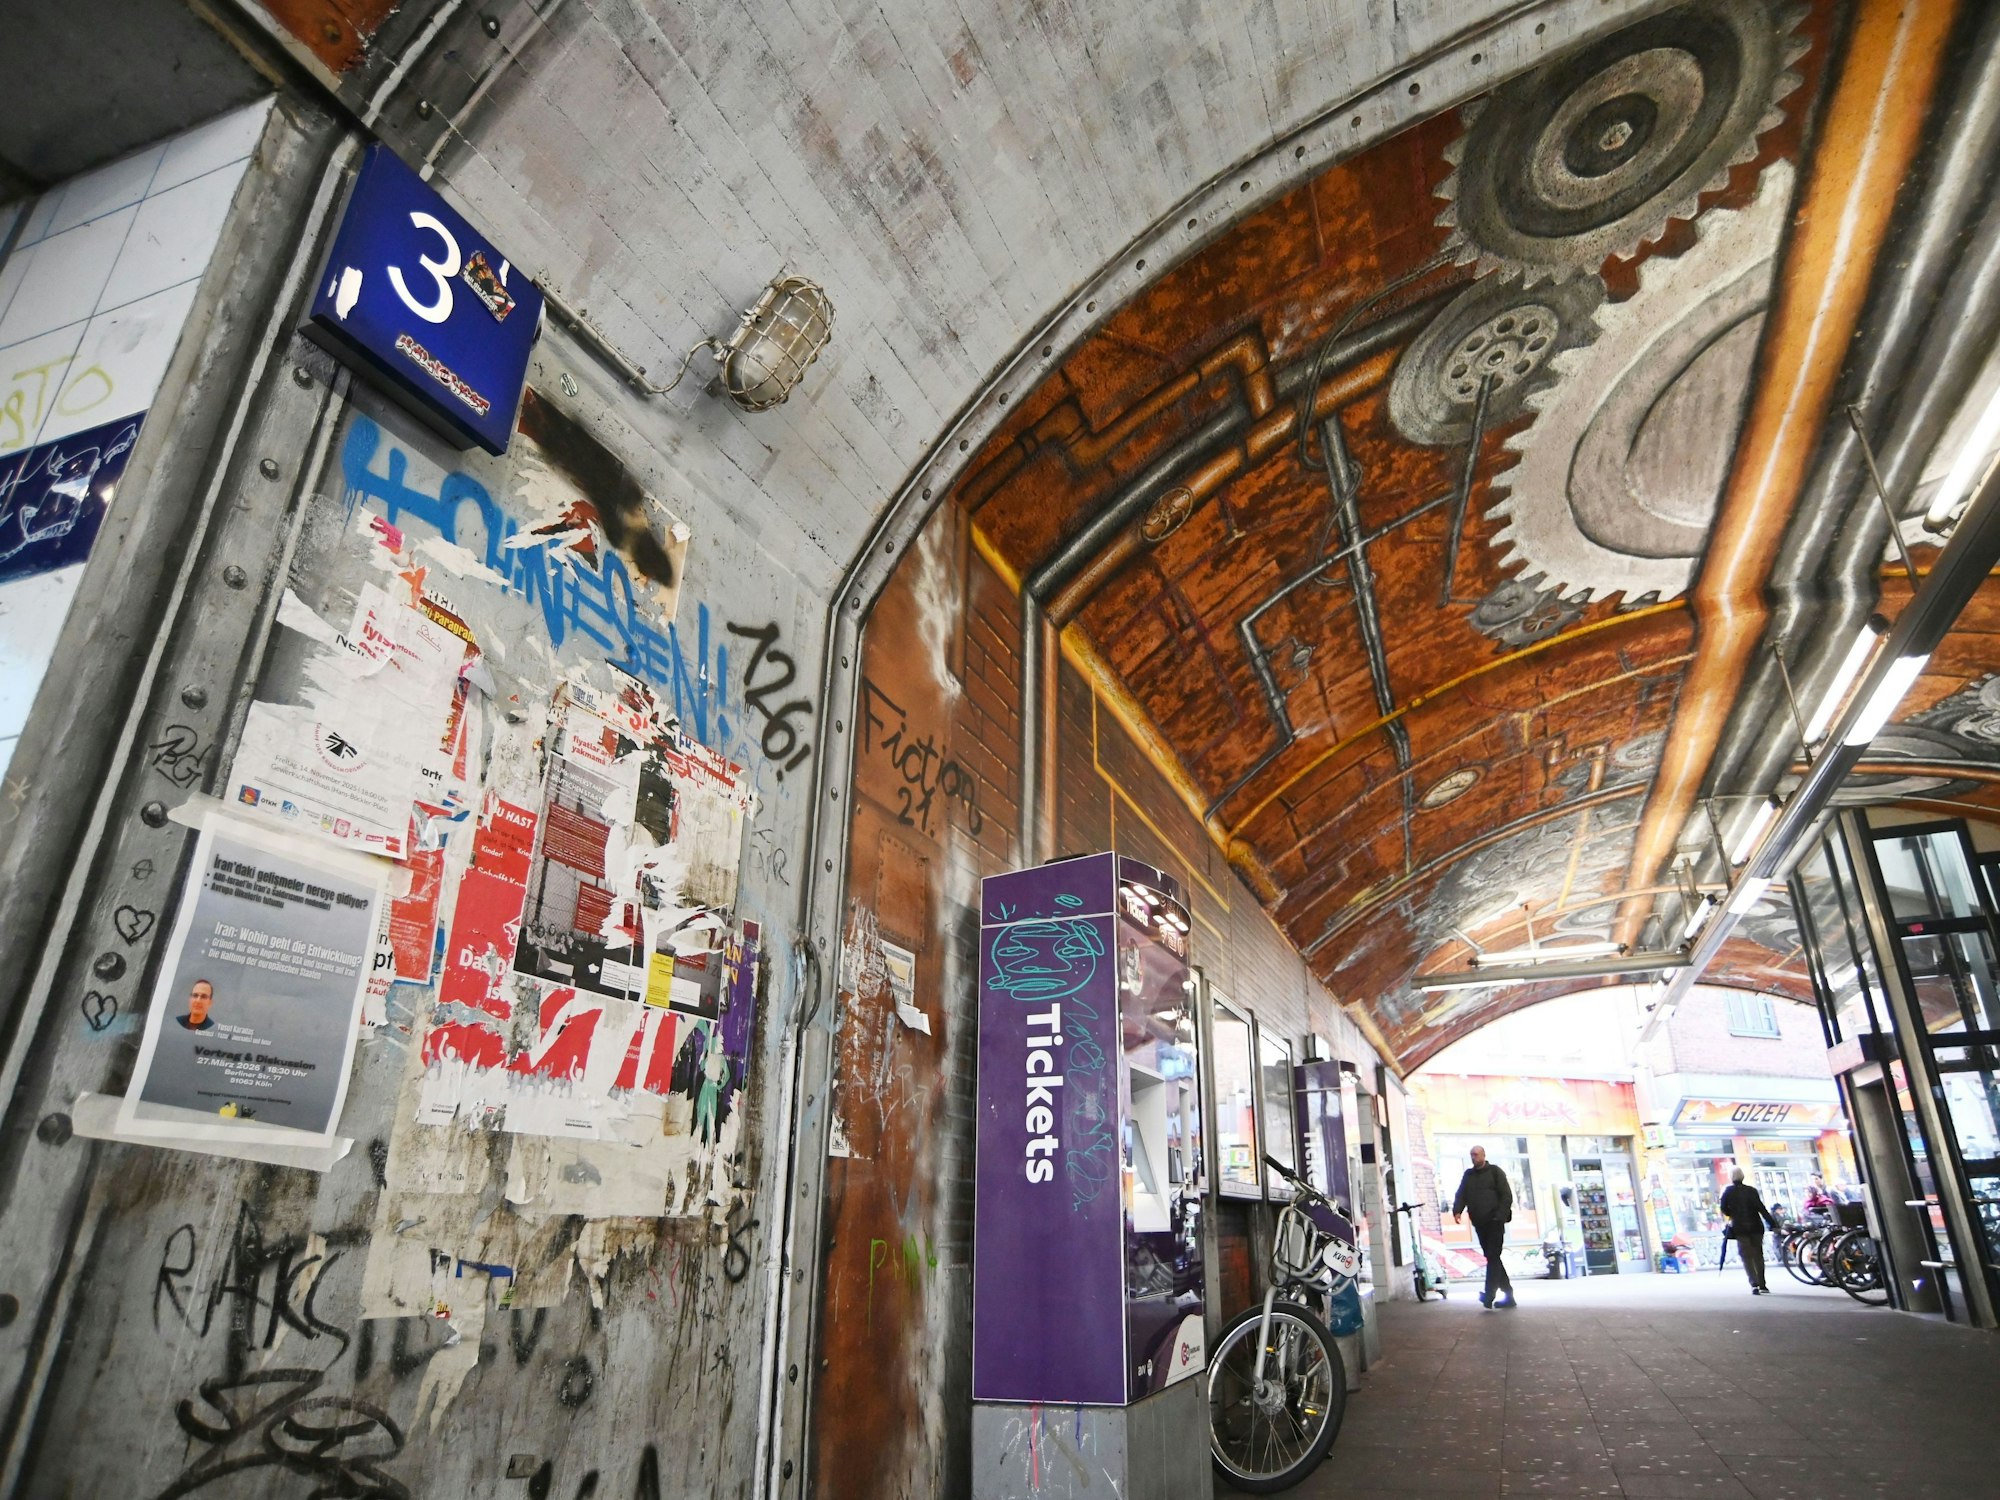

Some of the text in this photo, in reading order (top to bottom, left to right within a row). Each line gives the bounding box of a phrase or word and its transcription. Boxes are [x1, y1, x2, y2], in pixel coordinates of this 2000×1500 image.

[388, 212, 462, 324] 3
[271, 764, 331, 790] Gewerkschaftshaus
[310, 768, 341, 785] November
[342, 780, 356, 792] 2025
[550, 773, 584, 794] DEUTSCHEN
[504, 810, 534, 829] HAST
[305, 883, 335, 902] nereye
[335, 892, 369, 911] gidiyor?
[211, 936, 235, 950] Gründe
[236, 942, 246, 952] für
[246, 945, 259, 955] den
[259, 948, 280, 961] Angriff
[280, 953, 292, 962] der
[291, 955, 303, 965] USA
[303, 958, 315, 967] und
[335, 965, 344, 974] auf
[214, 920, 363, 968] Iran: Wohin geht die Entwicklung?
[208, 947, 321, 980] Die Haltung der europäischen Staaten
[193, 1045, 316, 1070] Vortrag & Diskussion
[196, 1056, 235, 1068] 27.März
[267, 1066, 289, 1075] 18:30
[291, 1069, 307, 1077] Uhr
[224, 1068, 256, 1078] Berliner
[255, 1079, 272, 1088] Köln
[1025, 1003, 1063, 1184] Tickets
[1731, 1103, 1792, 1122] GIZEH
[1332, 1251, 1347, 1263] KVB
